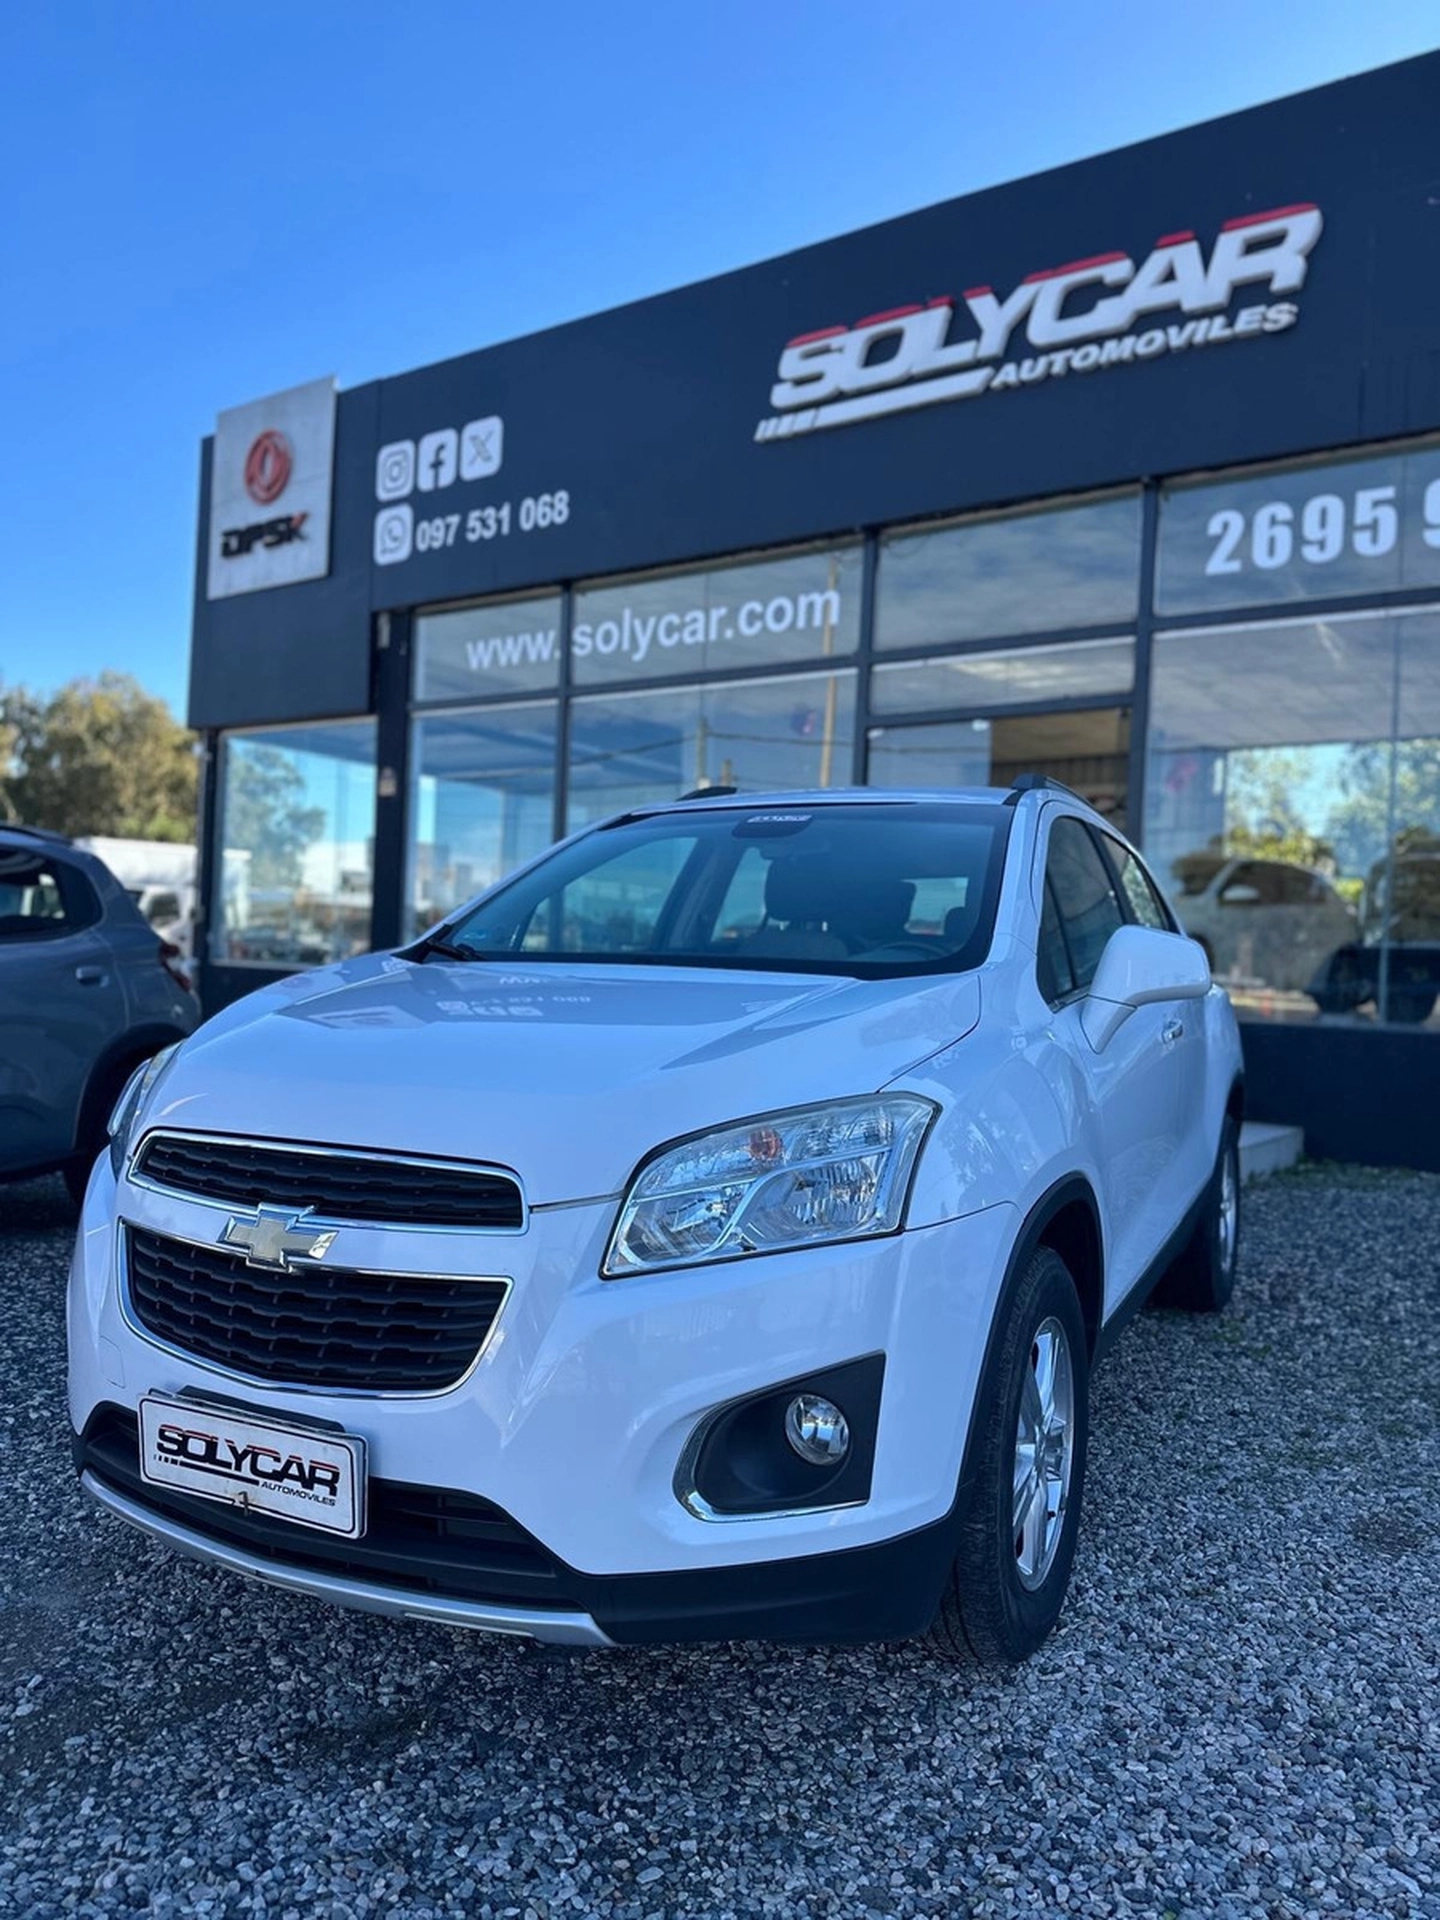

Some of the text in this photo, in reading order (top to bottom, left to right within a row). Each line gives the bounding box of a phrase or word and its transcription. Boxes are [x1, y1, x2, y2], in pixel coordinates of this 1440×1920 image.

[769, 202, 1322, 411] SOLYCAR
[989, 303, 1299, 390] AUTOMOVILES
[416, 490, 570, 552] 097 531 068
[1205, 486, 1398, 575] 2695
[156, 1424, 341, 1497] SOLYCAR
[260, 1480, 337, 1507] AUTOMOVILES
